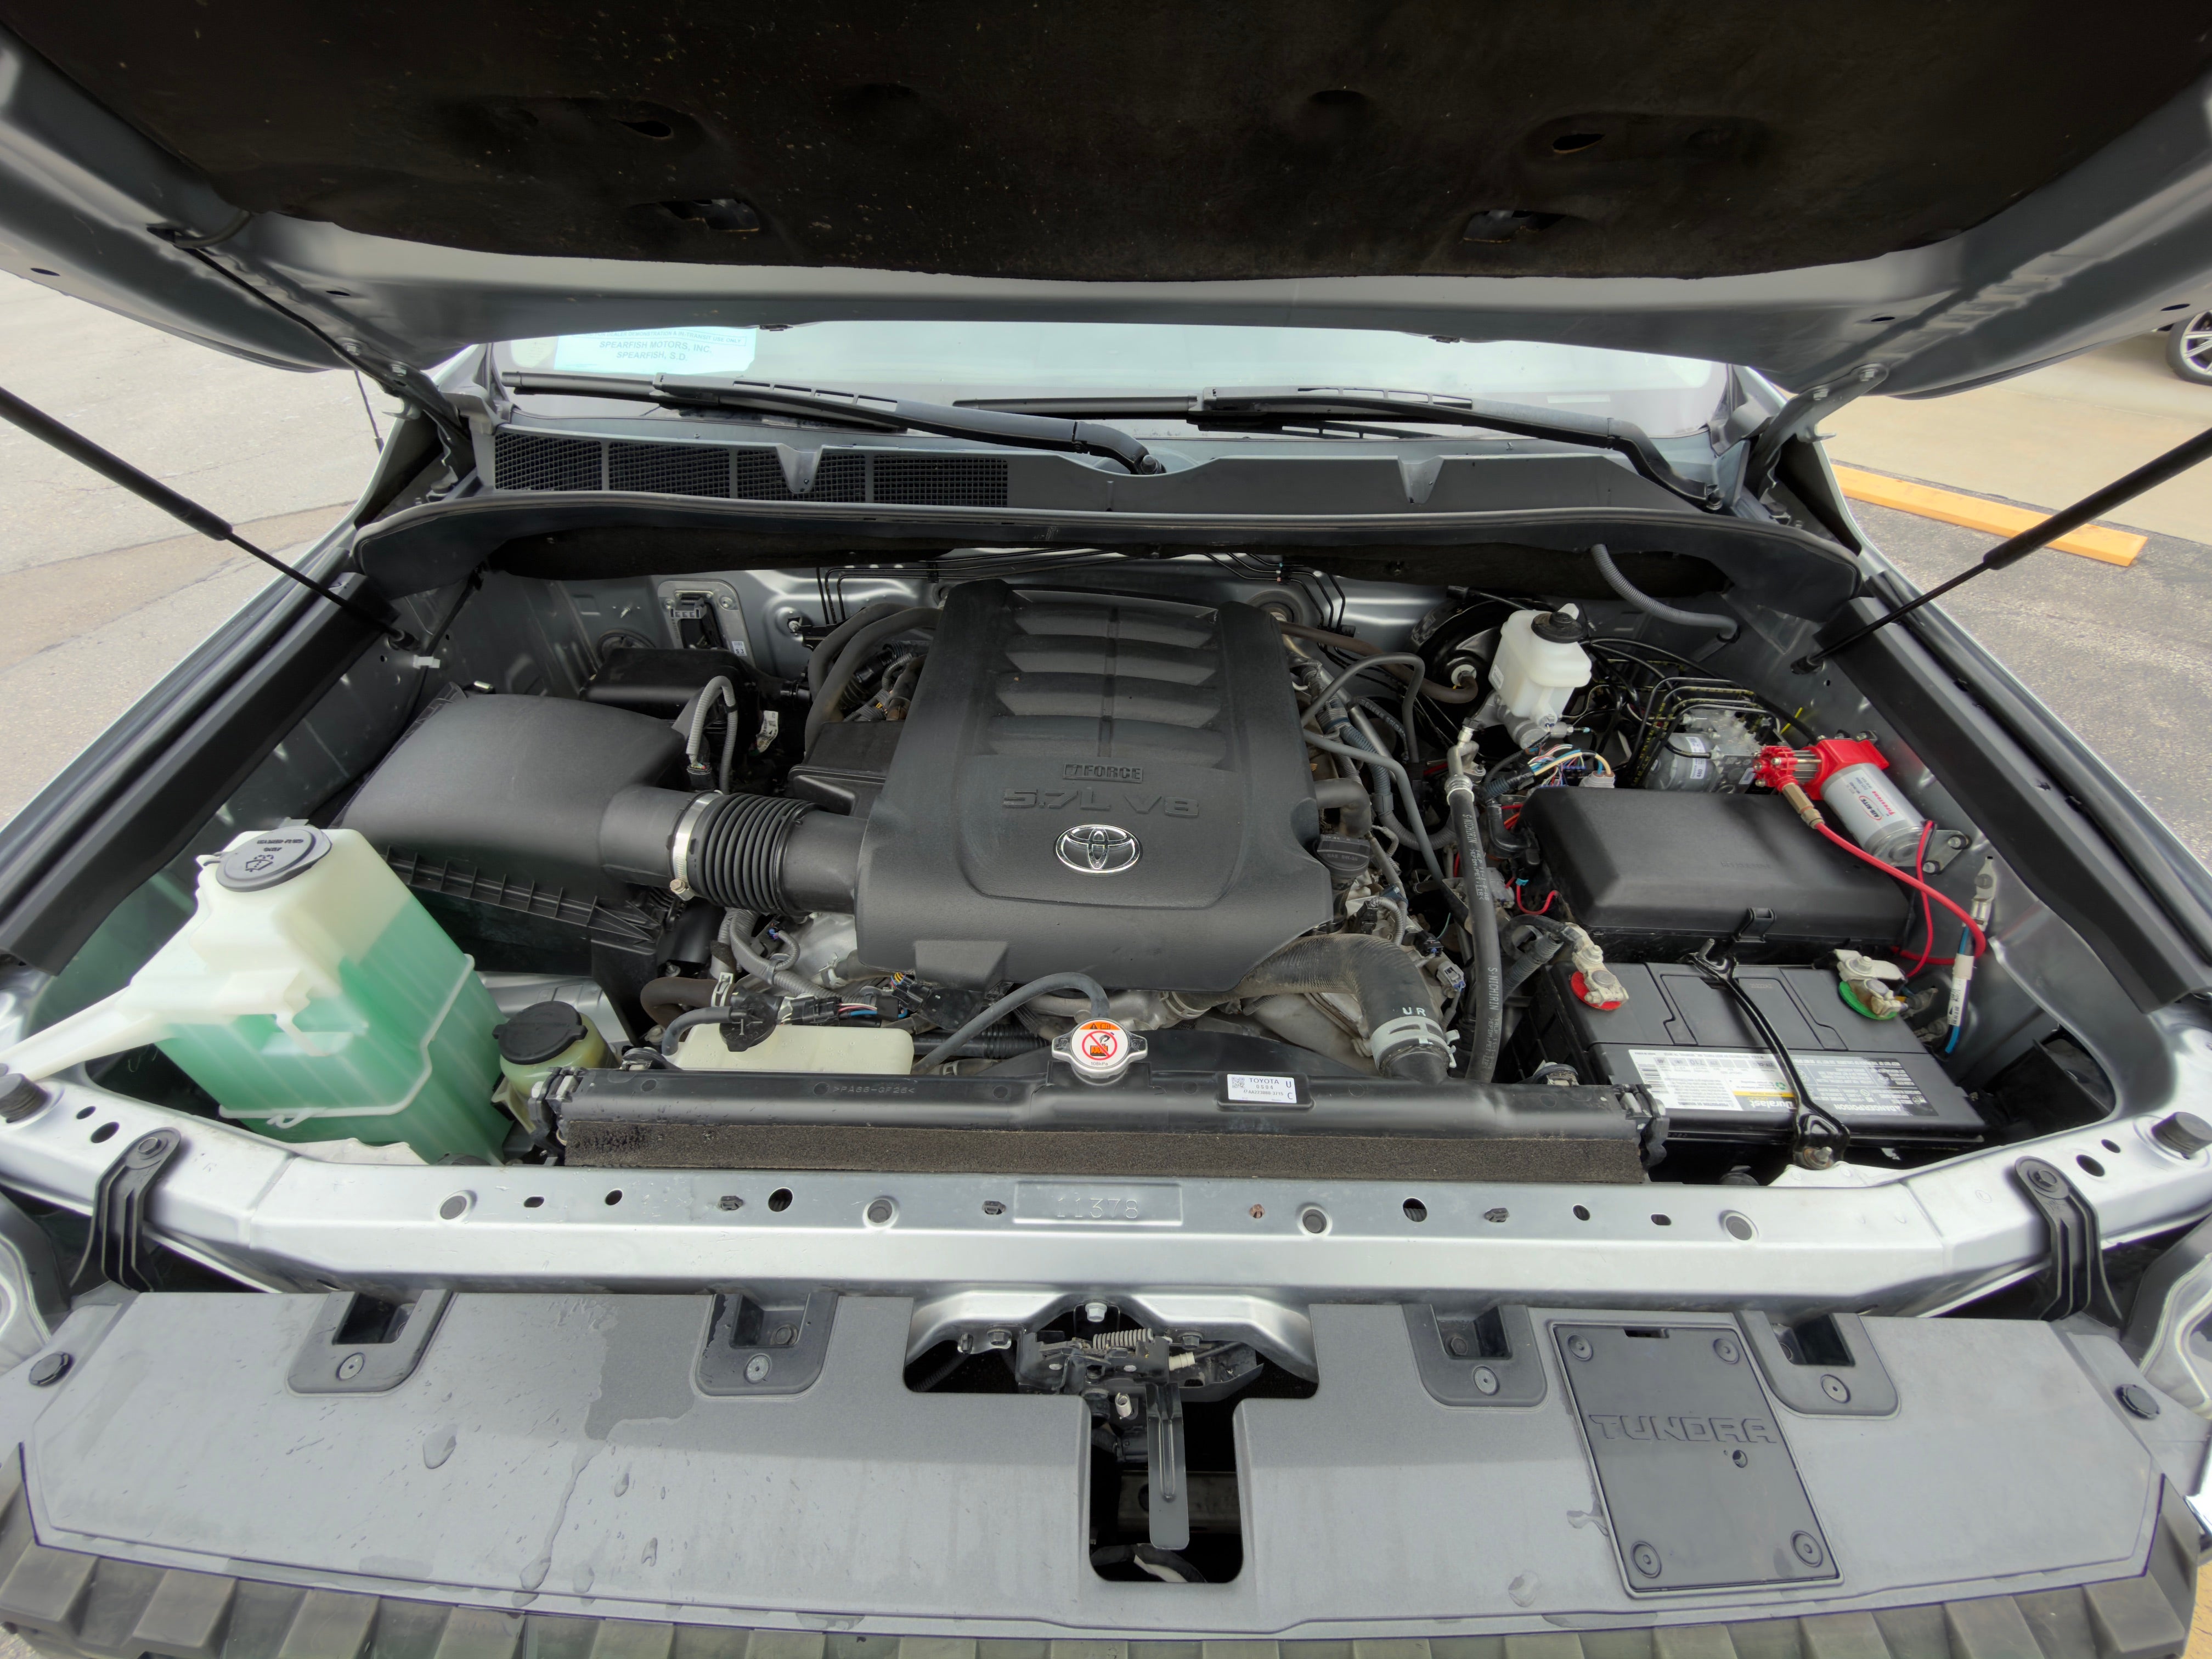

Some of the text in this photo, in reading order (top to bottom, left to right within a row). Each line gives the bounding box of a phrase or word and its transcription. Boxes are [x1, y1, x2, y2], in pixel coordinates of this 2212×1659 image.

[650, 341, 690, 351] MOTORS,
[693, 344, 712, 353] INC.
[617, 351, 688, 361] SPEARFISH, S.D.
[1001, 788, 1199, 818] 5.7L V8
[1872, 791, 1895, 815] Firestone
[1285, 1080, 1292, 1088] U
[1749, 1099, 1795, 1109] Duralast
[1057, 1197, 1139, 1219] 11378
[1588, 1414, 1778, 1444] TUNDRA
